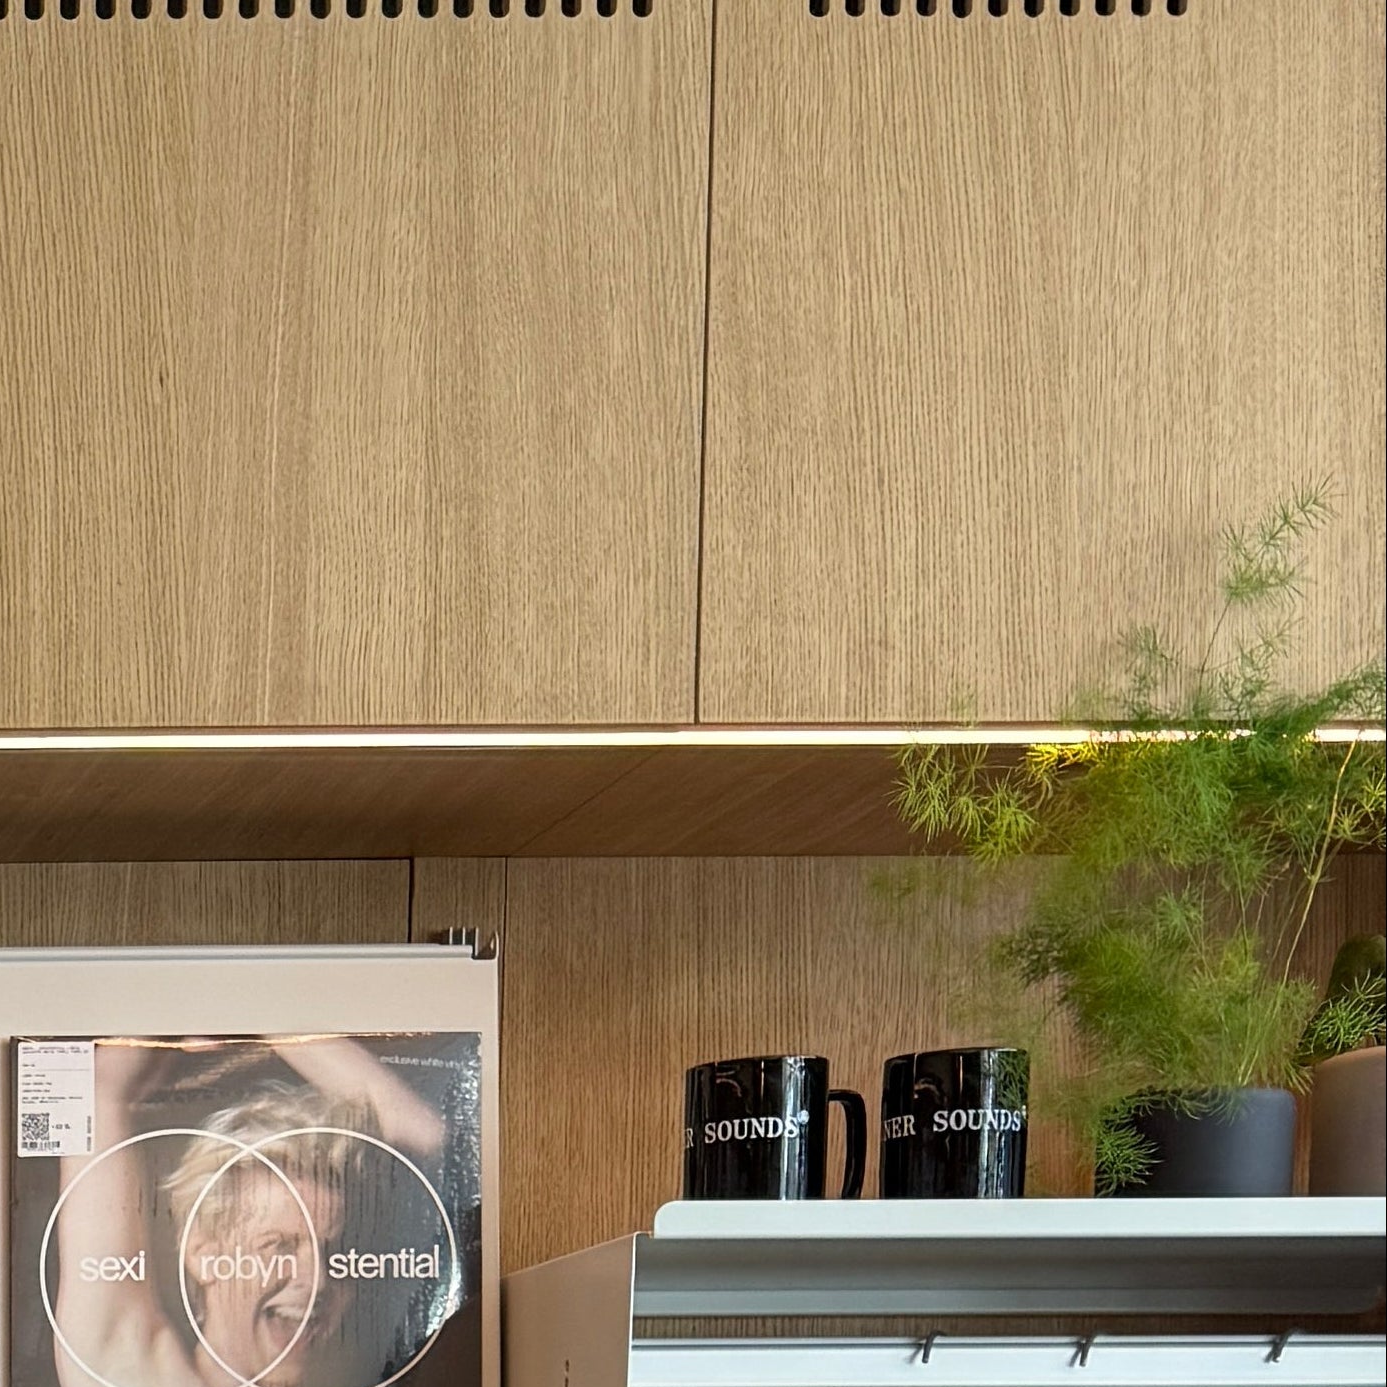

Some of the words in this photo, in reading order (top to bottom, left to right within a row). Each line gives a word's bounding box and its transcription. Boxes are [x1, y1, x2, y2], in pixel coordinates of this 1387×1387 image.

[705, 1115, 800, 1144] SOUNDS
[933, 1108, 1022, 1132] SOUNDS
[79, 1250, 146, 1282] sexi
[200, 1246, 298, 1288] robyn
[328, 1244, 440, 1279] stential
